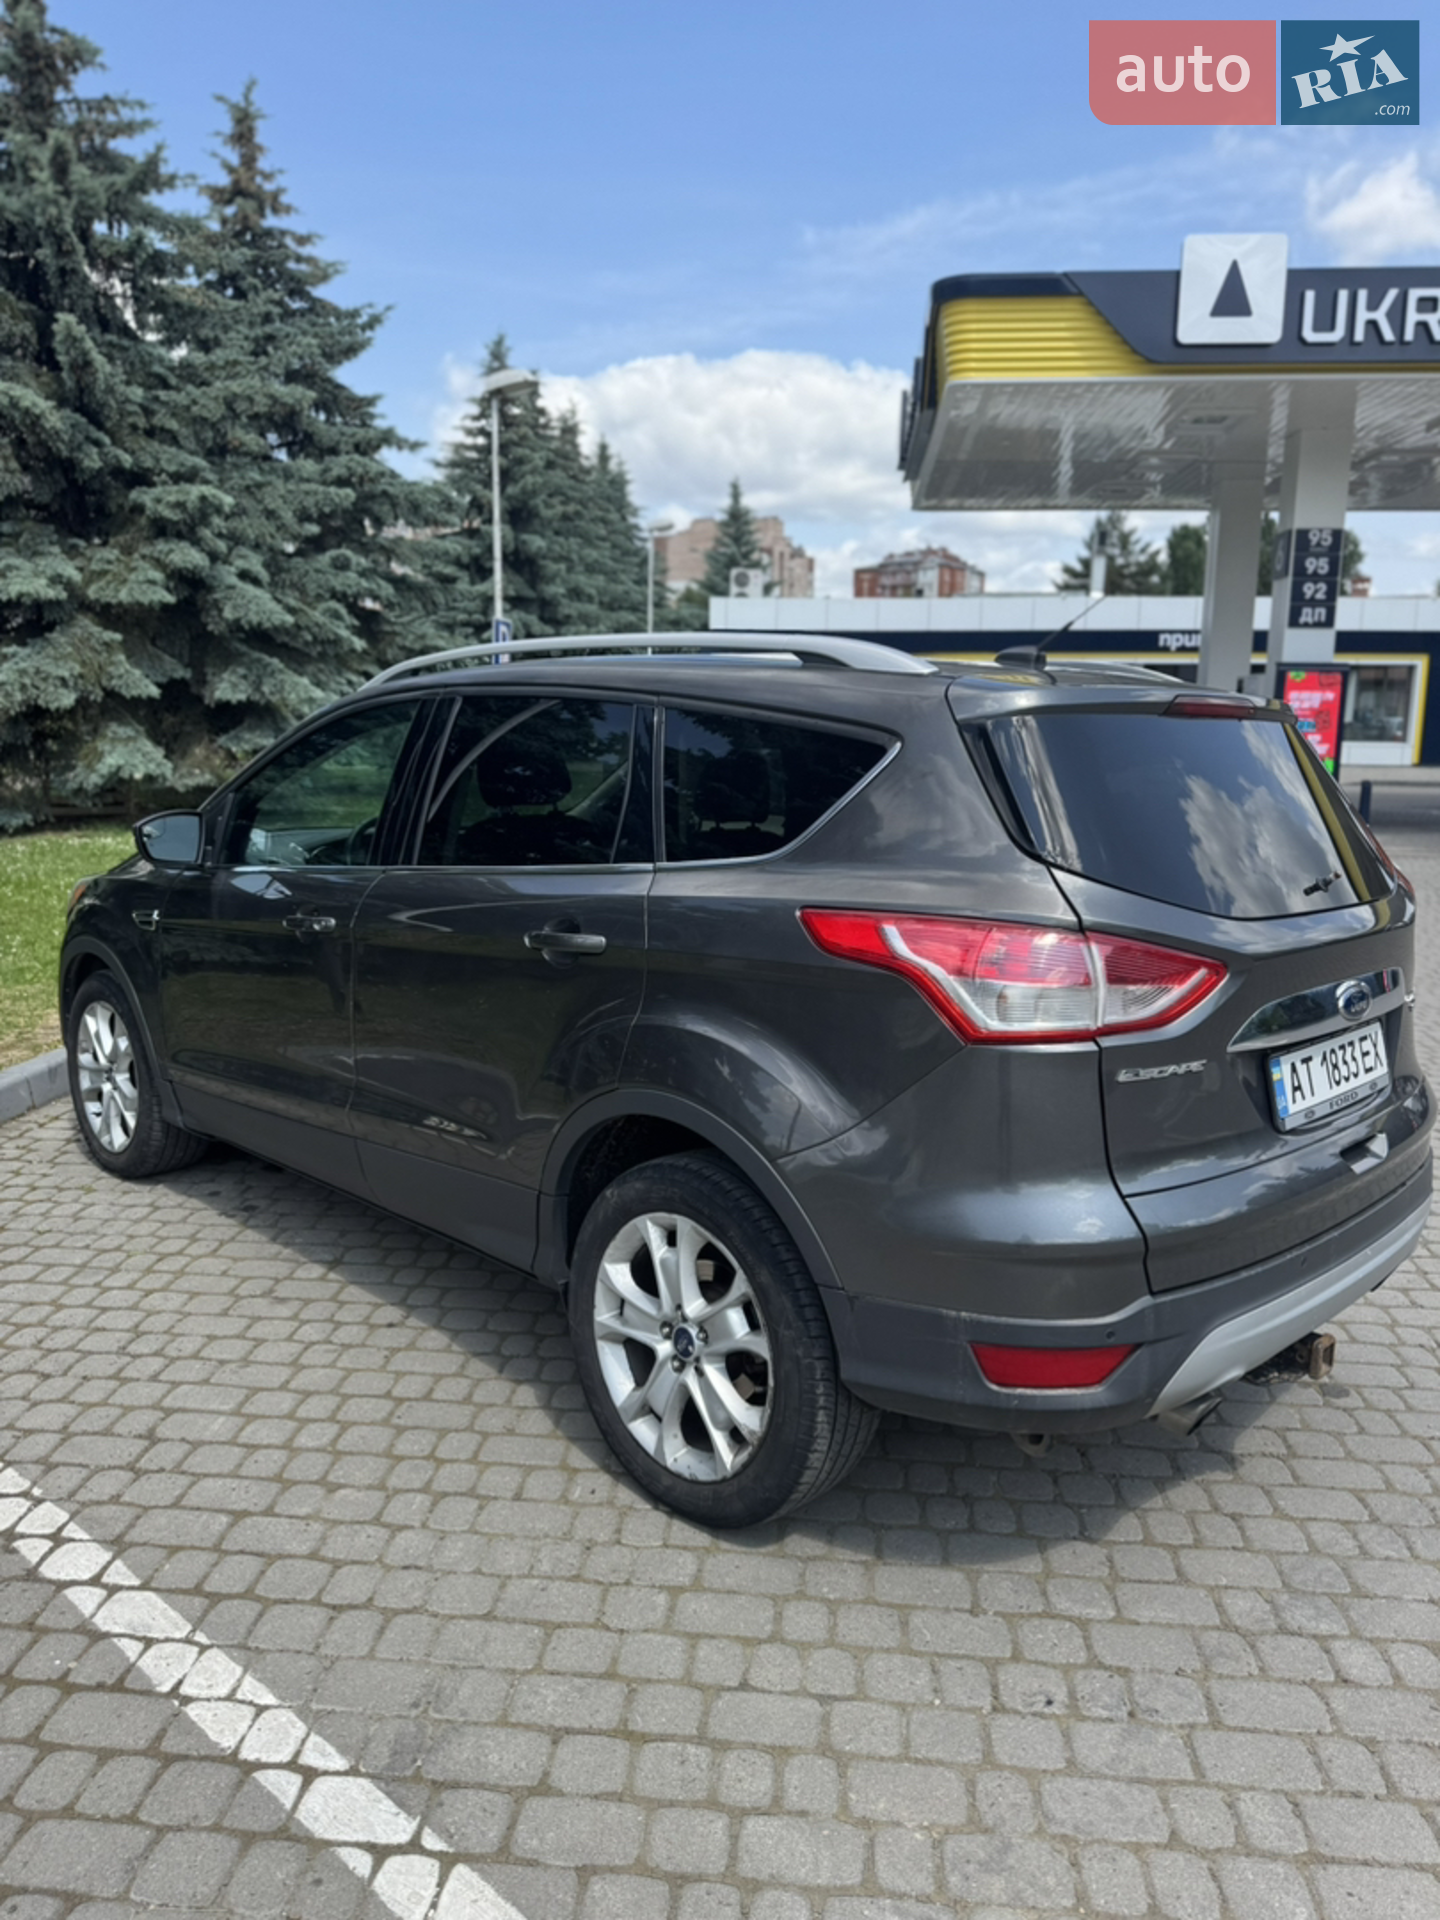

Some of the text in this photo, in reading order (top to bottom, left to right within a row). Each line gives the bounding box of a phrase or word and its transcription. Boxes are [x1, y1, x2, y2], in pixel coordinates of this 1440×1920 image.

[1301, 287, 1440, 343] UKR
[1308, 529, 1333, 546] 95
[1305, 557, 1330, 575] 95
[1302, 582, 1328, 600] 92
[1299, 607, 1327, 625] ДП
[1158, 633, 1201, 651] при
[1290, 1030, 1384, 1104] AT 1833 EX
